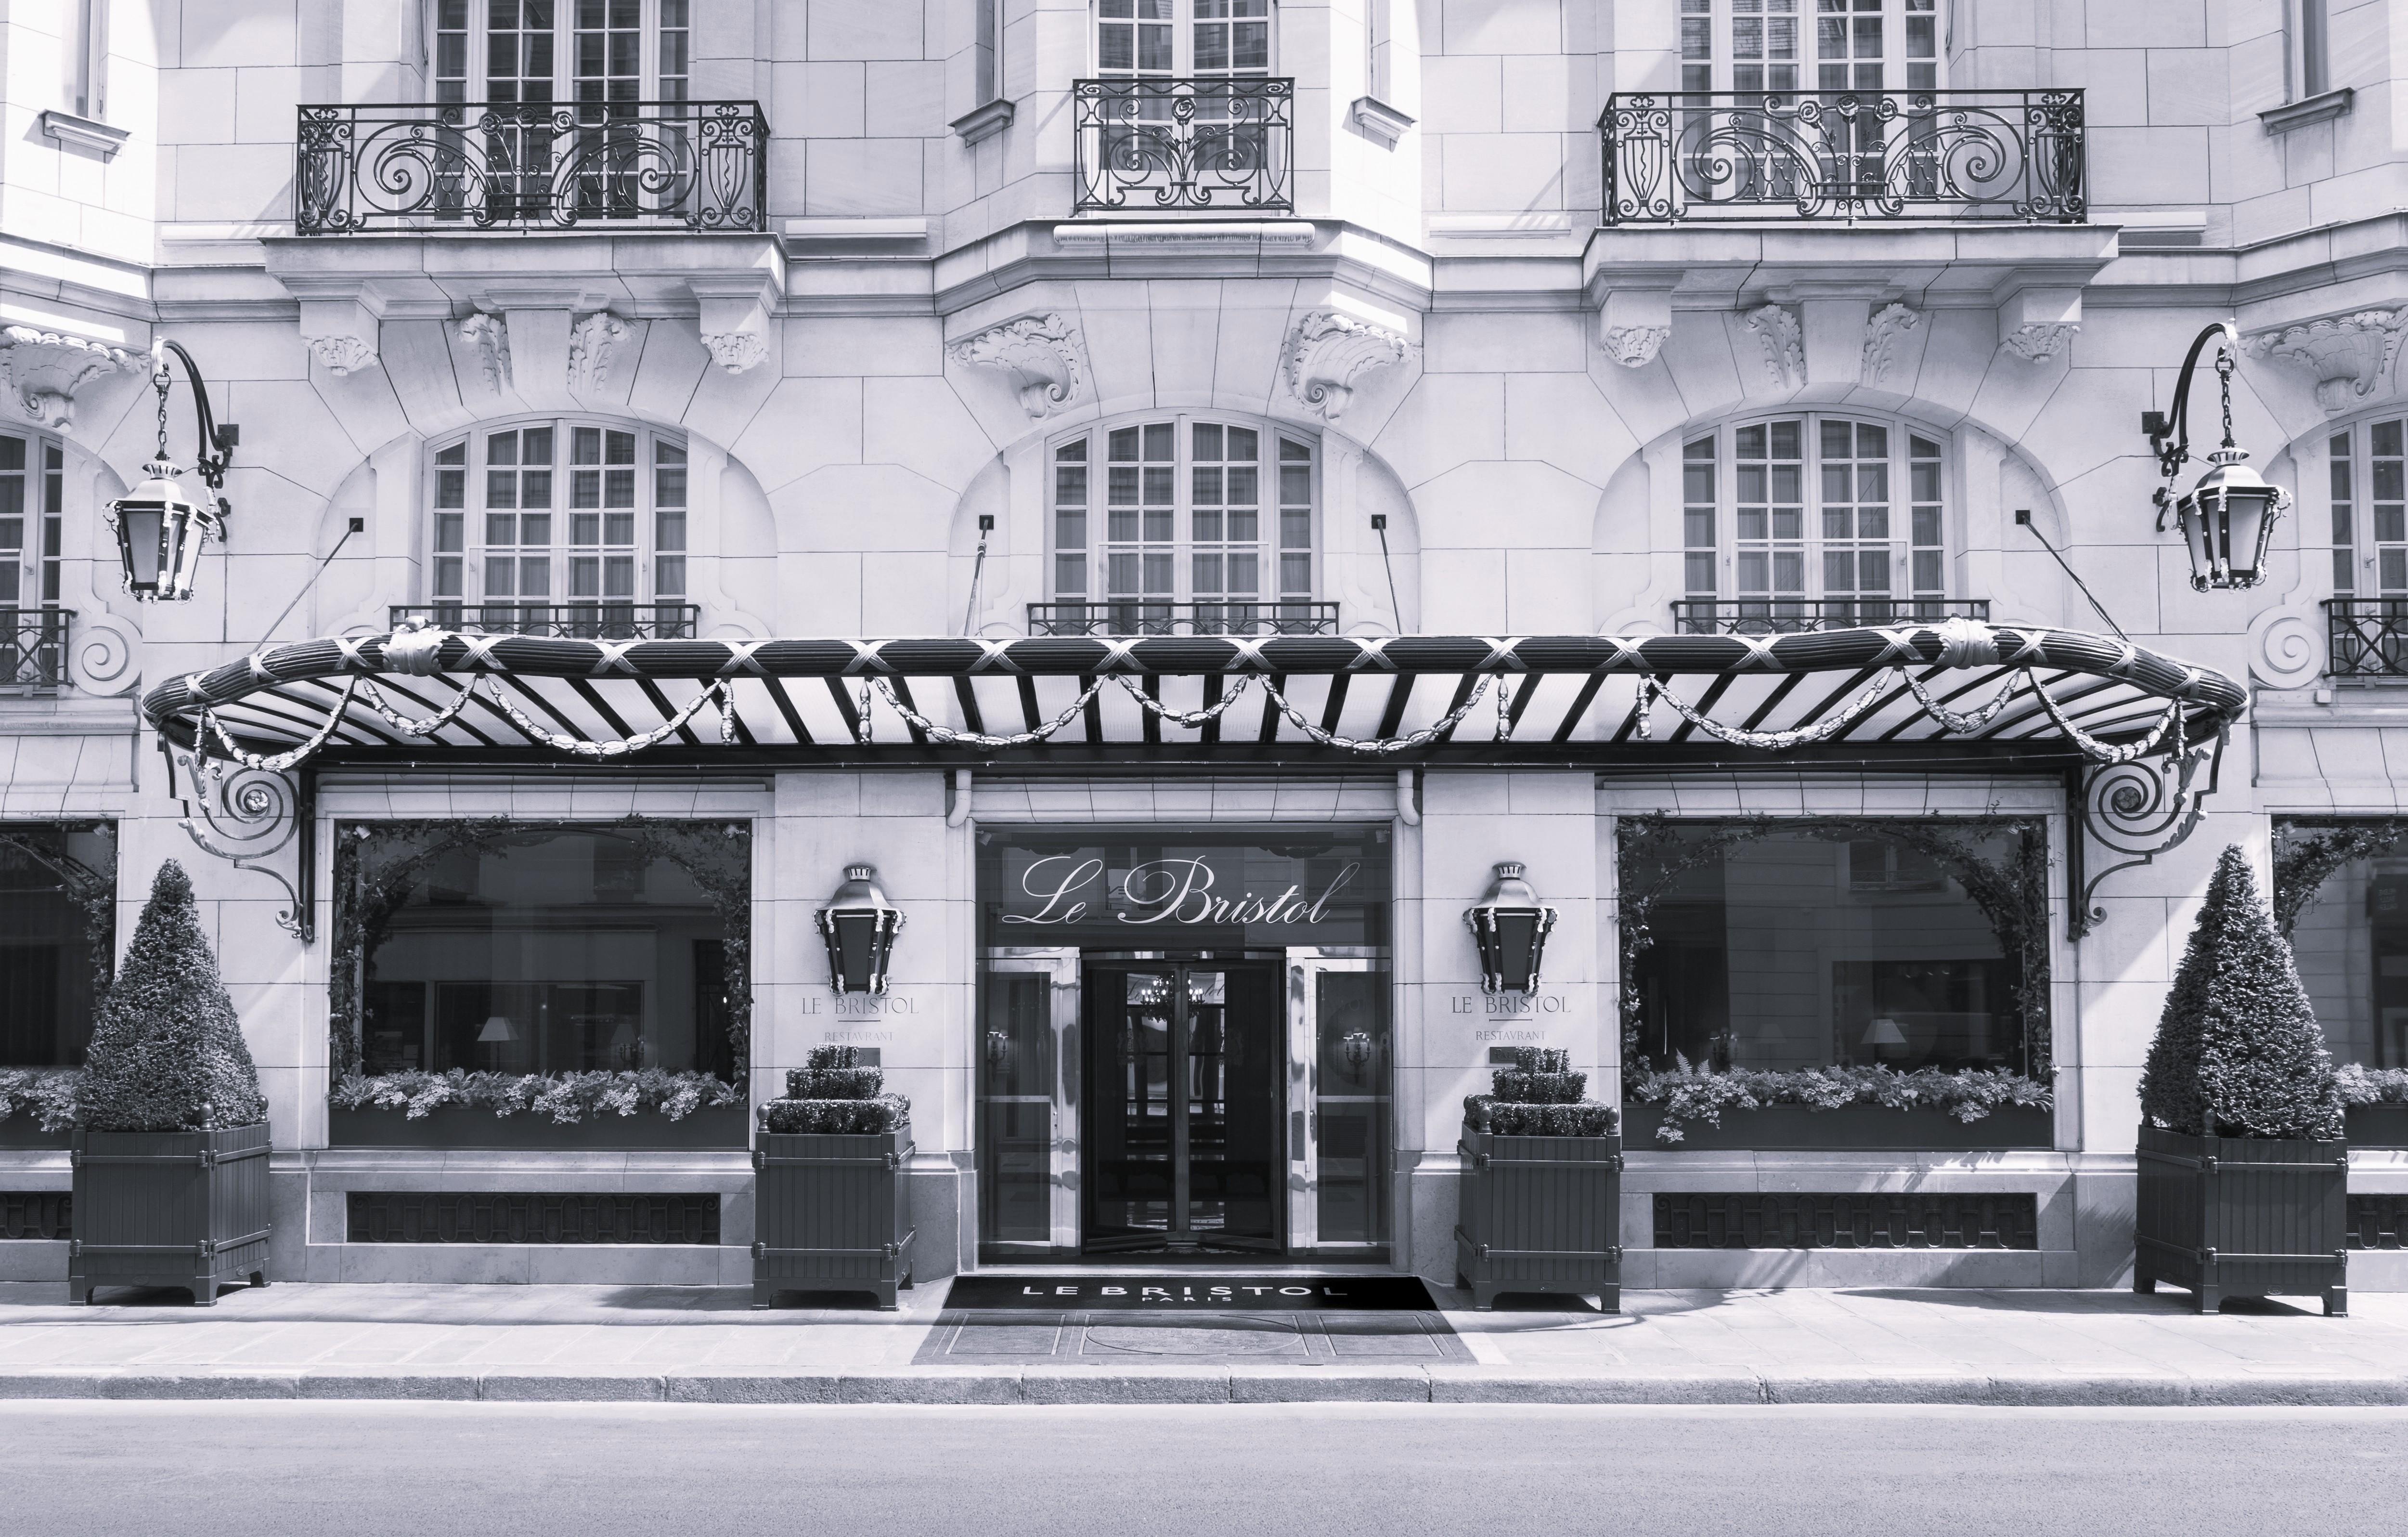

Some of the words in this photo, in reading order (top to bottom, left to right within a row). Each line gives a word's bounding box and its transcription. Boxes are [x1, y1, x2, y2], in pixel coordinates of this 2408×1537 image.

[1002, 856, 1103, 924] Le
[1117, 855, 1360, 924] Bristol
[802, 998, 821, 1014] LE
[835, 997, 919, 1014] BRISTOL
[1452, 997, 1472, 1013] LE
[1485, 996, 1571, 1013] BRISTOL
[1023, 1286, 1078, 1295] LE
[1101, 1286, 1347, 1296] BRISTOL
